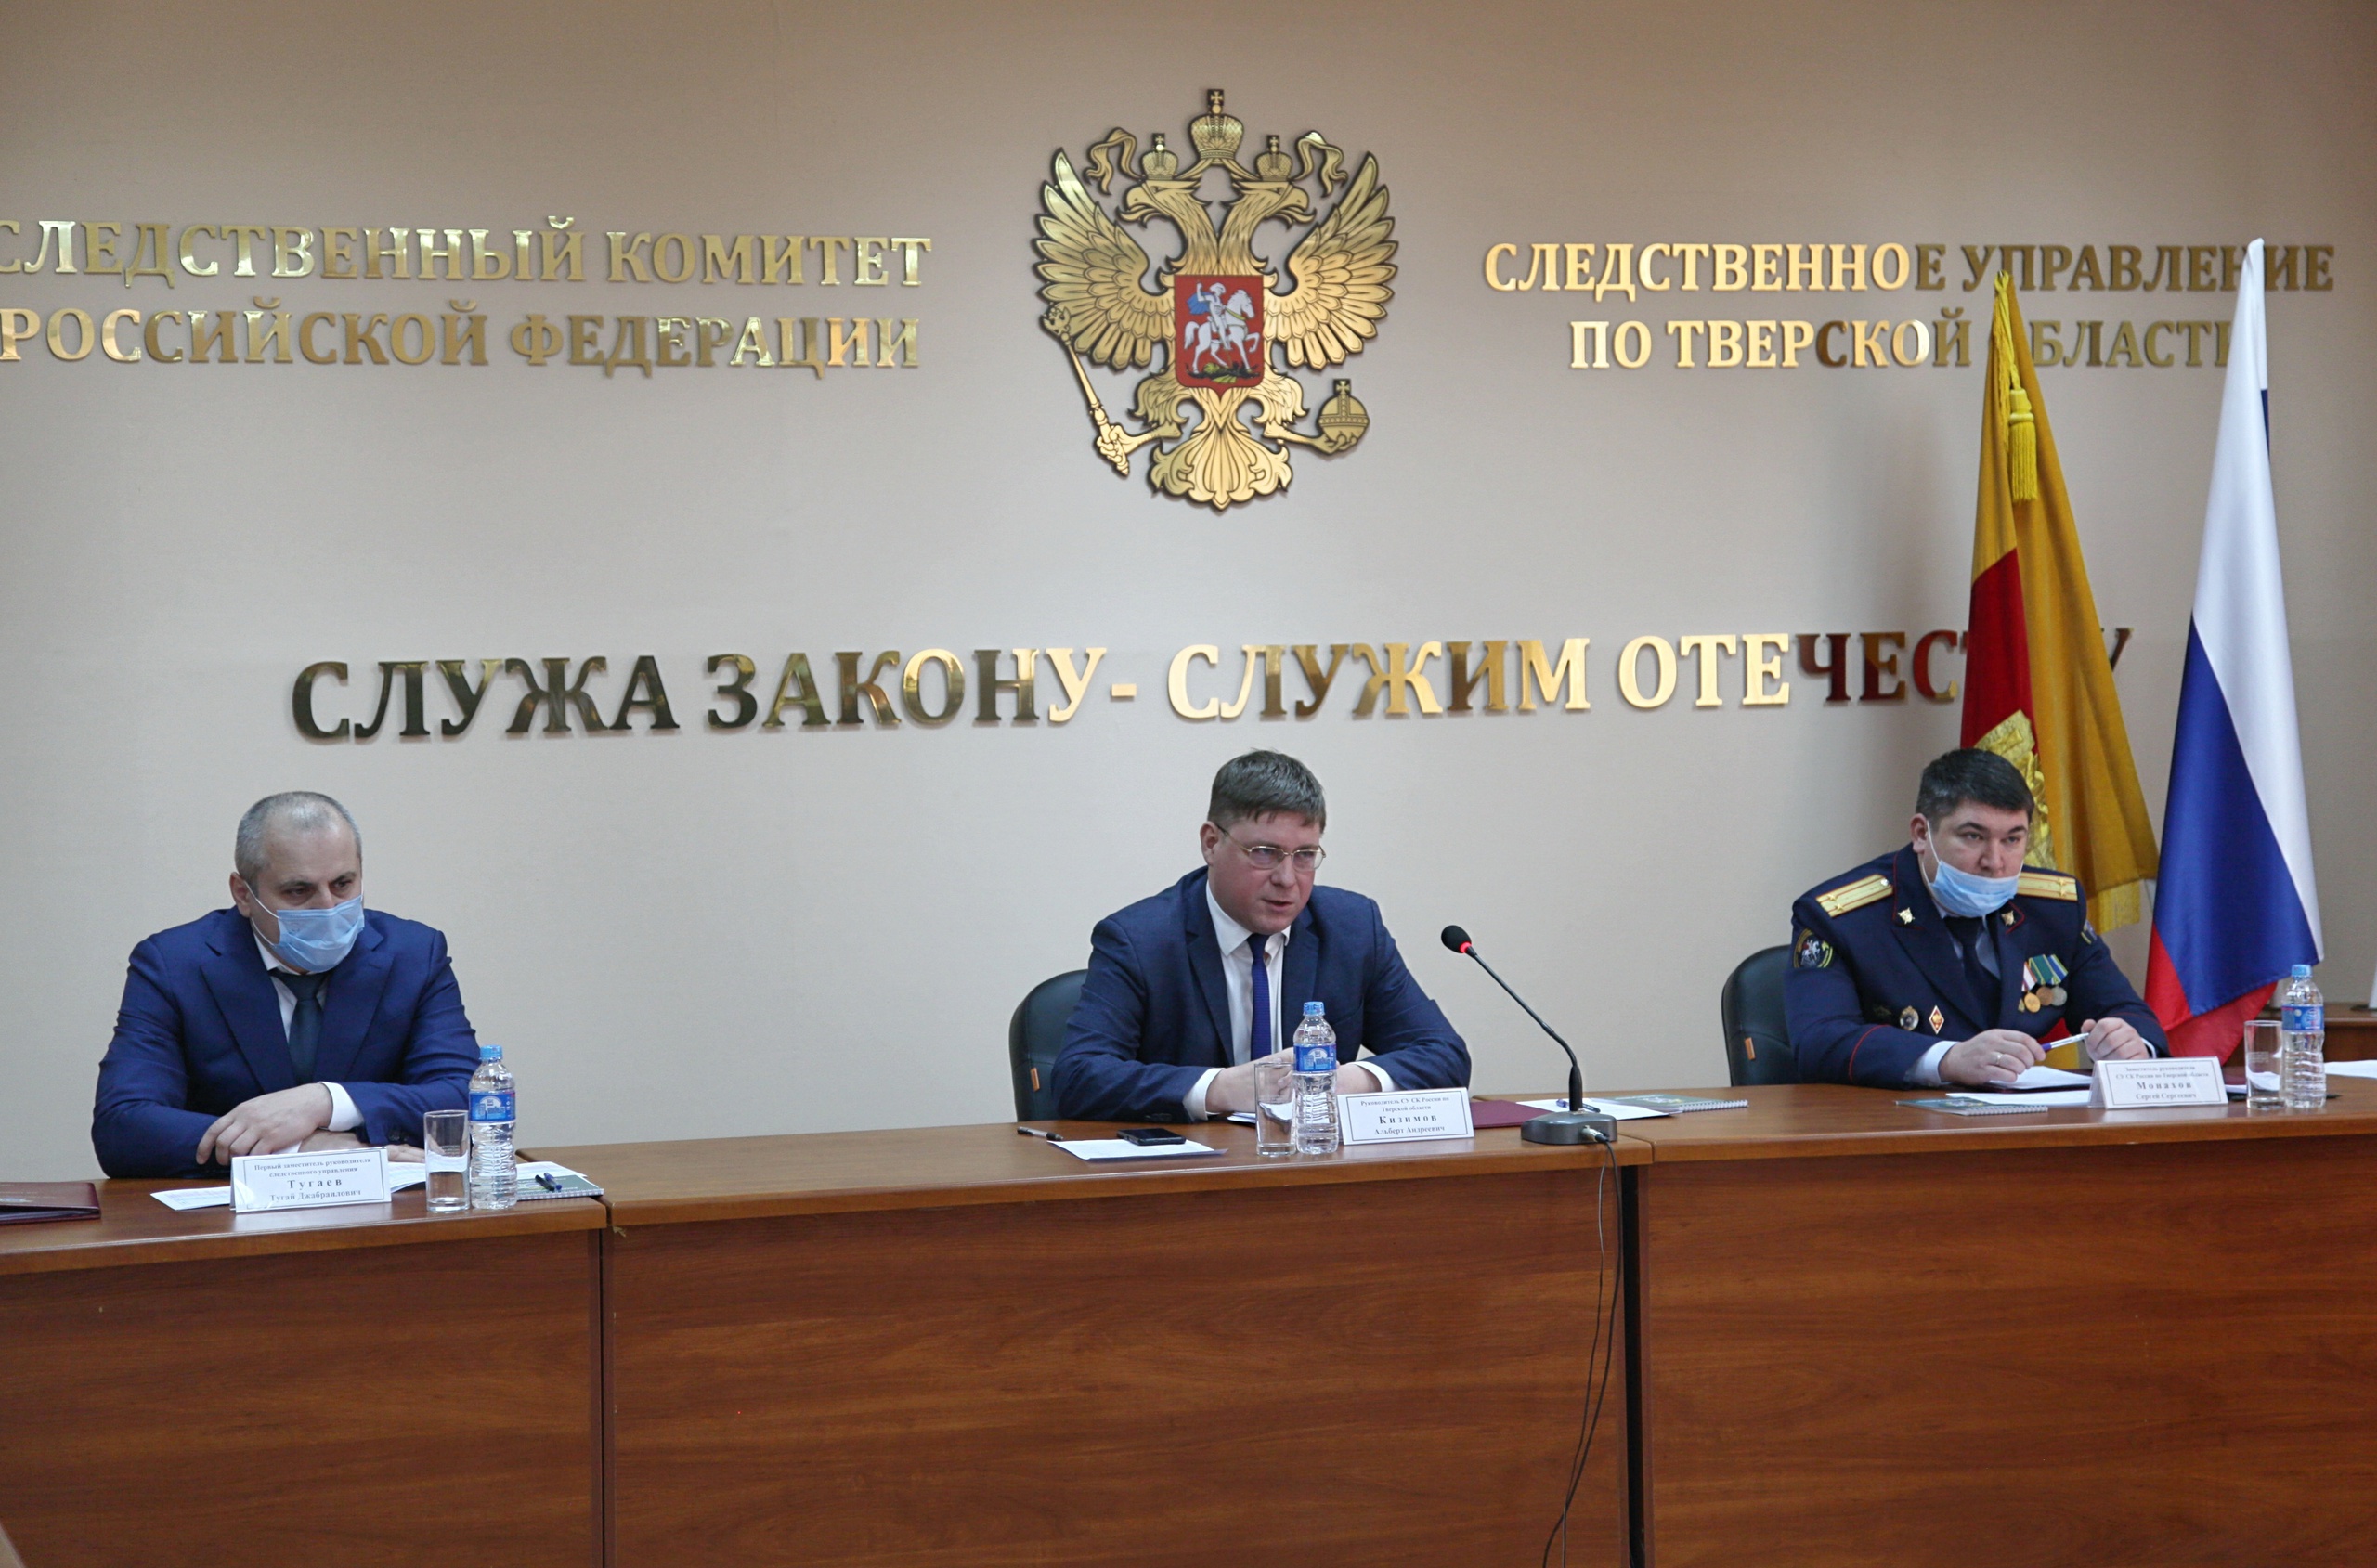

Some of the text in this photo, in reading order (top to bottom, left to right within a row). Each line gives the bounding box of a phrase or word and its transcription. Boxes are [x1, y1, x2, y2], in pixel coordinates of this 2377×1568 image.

[606, 230, 932, 287] КОМИТЕТ
[1485, 242, 1947, 303] СЛЕДСТВЕННОЕ
[0, 295, 920, 381] РОССИЙСКОЙ ФЕДЕРАЦИИ
[1571, 320, 1653, 369] ПО
[1668, 306, 1972, 368] ТВЕРСКОЙ
[292, 654, 681, 740] СЛУЖА
[1167, 637, 1591, 719] СЛУЖИМ
[1617, 627, 2135, 710] ОТЕЧЕС
[1379, 1115, 1437, 1124] Кизимов
[1374, 1125, 1445, 1135] Альберт Андреевич
[283, 1160, 324, 1169] заместитель
[325, 1158, 371, 1167] руководителя
[318, 1167, 358, 1175] управления
[287, 1178, 343, 1191] Тугаев
[270, 1189, 362, 1202] Тугай Джабраилович
